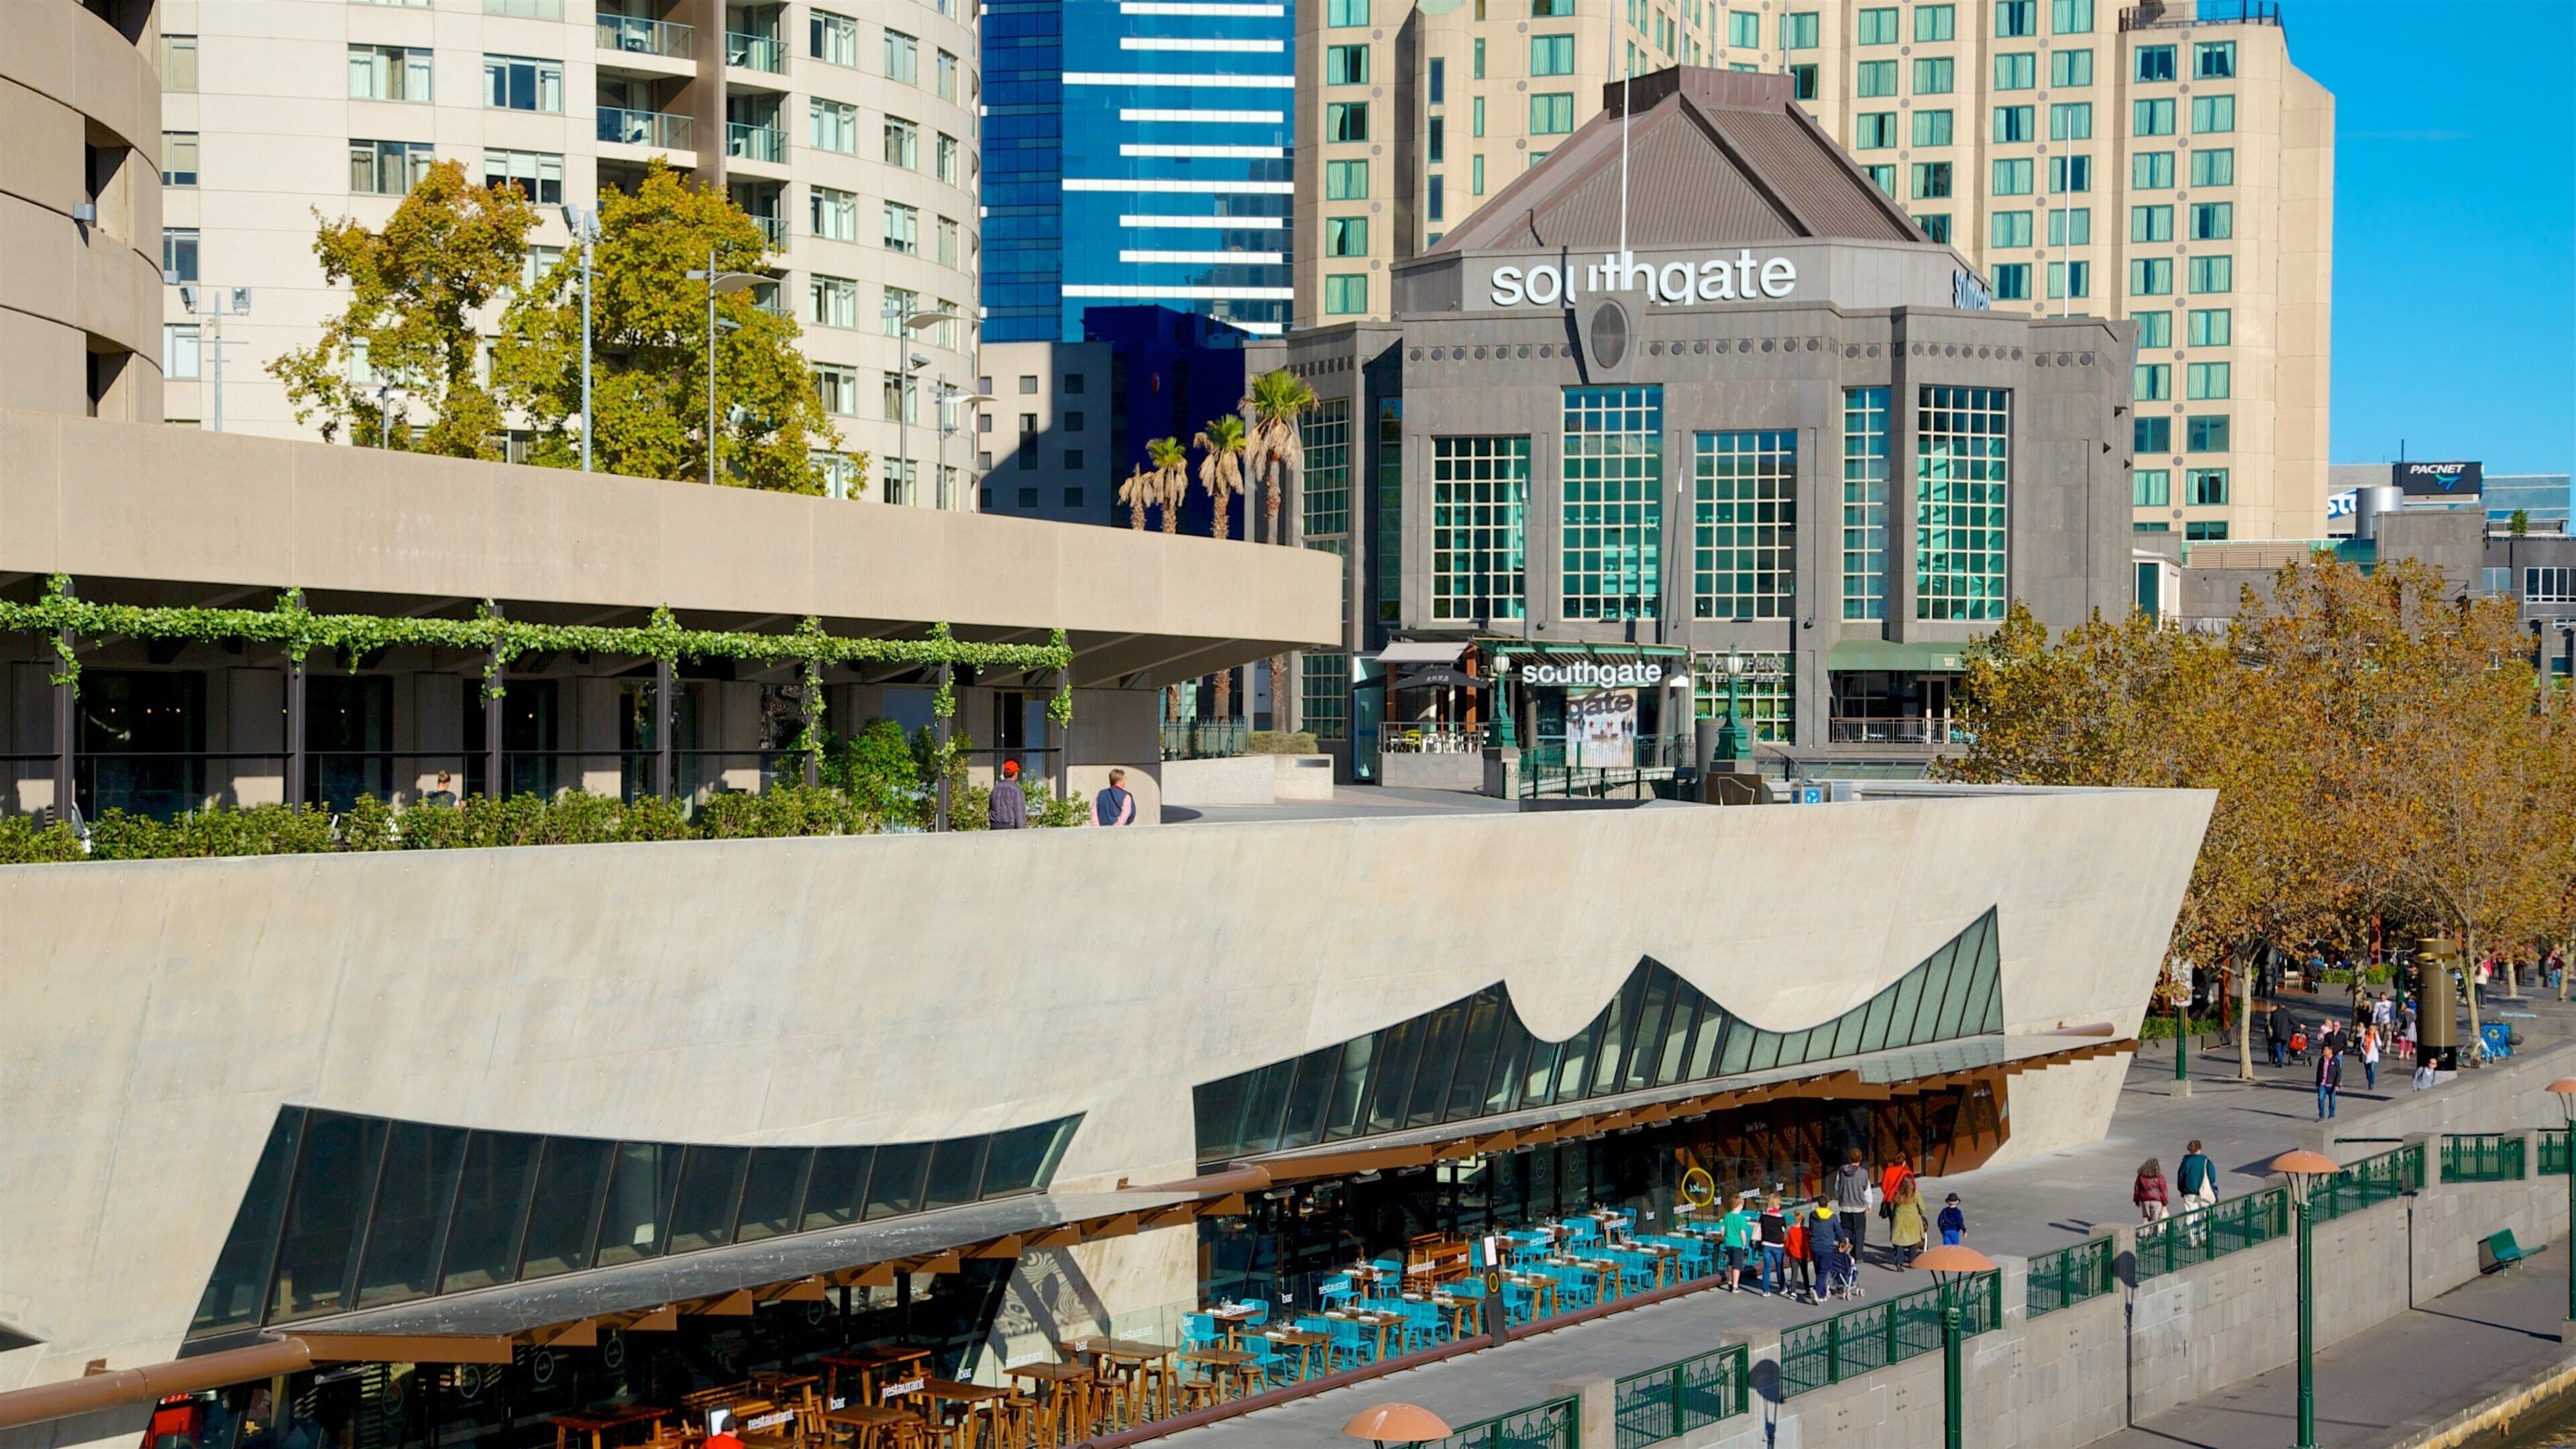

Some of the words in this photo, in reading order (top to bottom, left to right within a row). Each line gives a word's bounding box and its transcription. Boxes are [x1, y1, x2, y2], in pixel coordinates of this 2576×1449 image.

[1491, 249, 1796, 306] southgate
[2410, 464, 2465, 474] PACNET
[1522, 660, 1662, 688] southgate
[1646, 1211, 1655, 1221] bar
[1604, 1217, 1627, 1230] restaurant
[1575, 1227, 1583, 1236] bar
[1529, 1234, 1555, 1246] restaurant
[1457, 1254, 1467, 1263] bar
[1407, 1260, 1436, 1274] restaurant
[1373, 1272, 1383, 1282] bar
[1318, 1279, 1348, 1295] restaurant
[1281, 1293, 1293, 1303] bar
[1183, 1316, 1194, 1327] bar
[1119, 1325, 1154, 1341] restaurant
[1075, 1340, 1088, 1352] bar
[1006, 1350, 1044, 1368] restaurant
[958, 1366, 972, 1380] bar
[882, 1377, 925, 1397] restaurant
[830, 1396, 845, 1410] bar
[747, 1408, 794, 1430] restaurant
